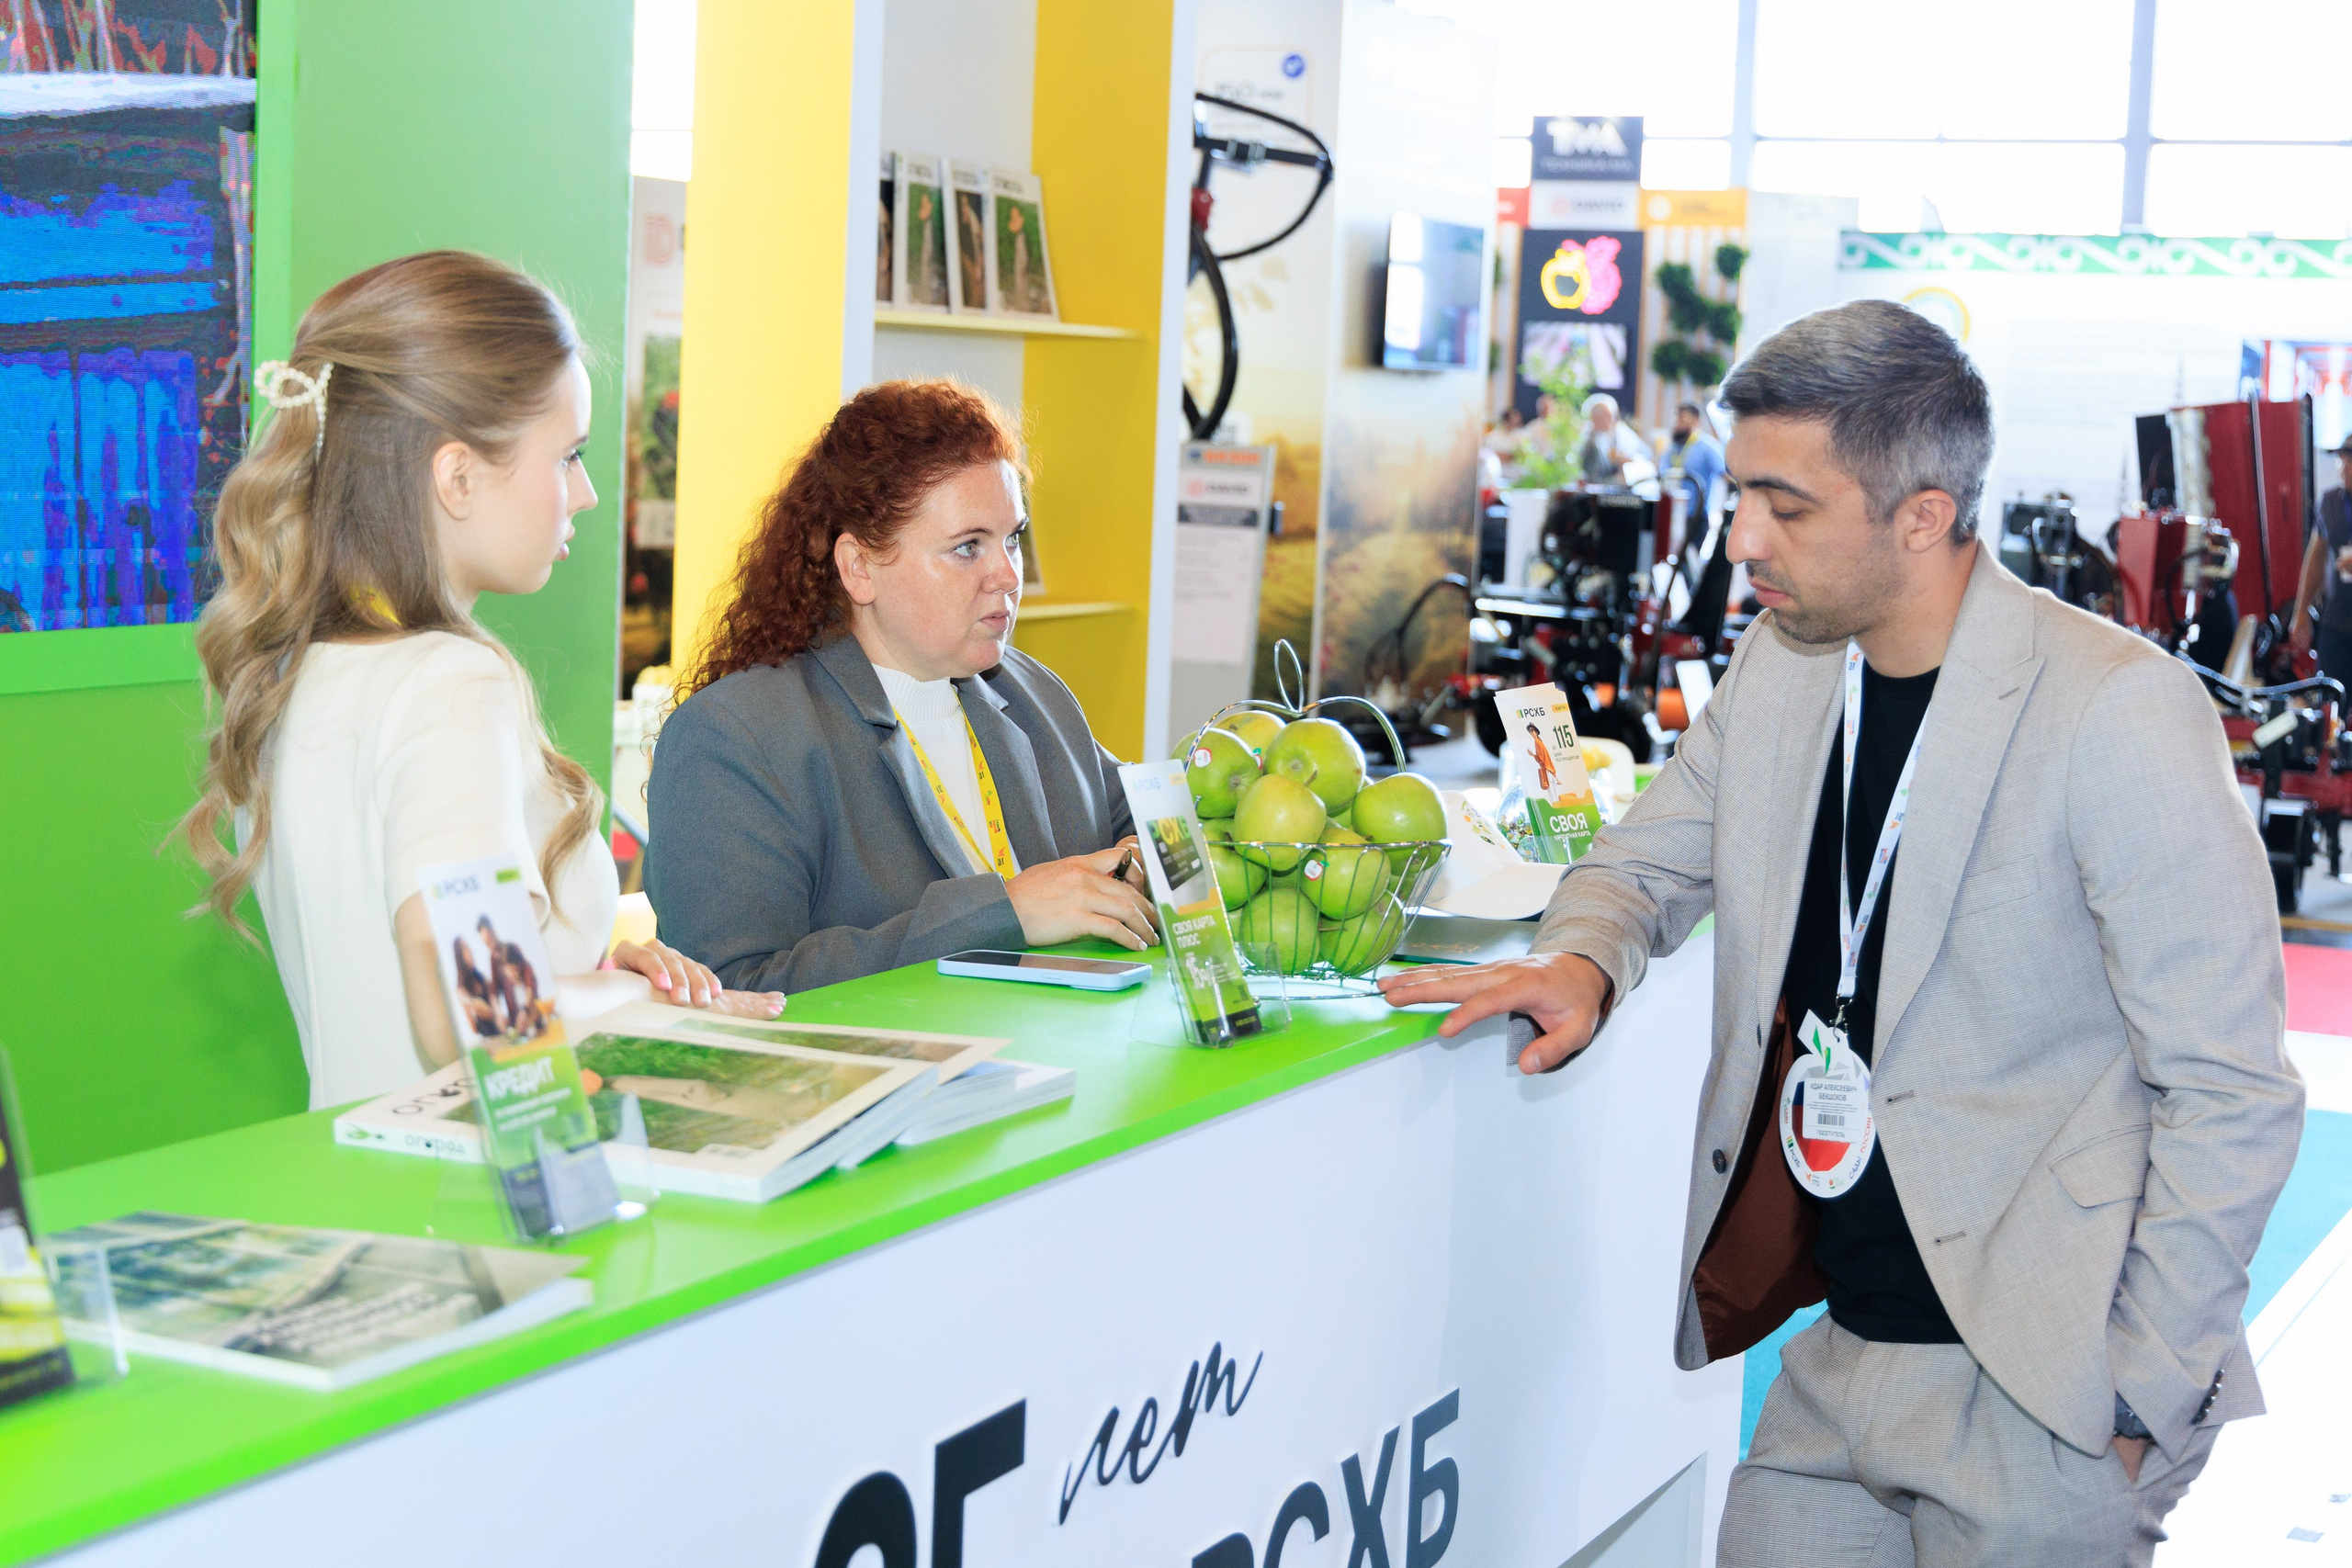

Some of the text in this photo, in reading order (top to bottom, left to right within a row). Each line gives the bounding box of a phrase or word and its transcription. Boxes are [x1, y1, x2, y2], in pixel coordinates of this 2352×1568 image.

[1523, 707, 1545, 718] РСХБ
[1553, 724, 1575, 749] 115
[1549, 812, 1589, 833] СВОЯ
[484, 1056, 556, 1100] КРЕДИТ
[1824, 1084, 1857, 1092] АЛЕКСЕЕВИЧ
[1816, 1129, 1845, 1138] ПОСЕТИТЕЛЬ
[1849, 1117, 1872, 1179] САДЫ РОССИИ
[1058, 1340, 1264, 1527] лет
